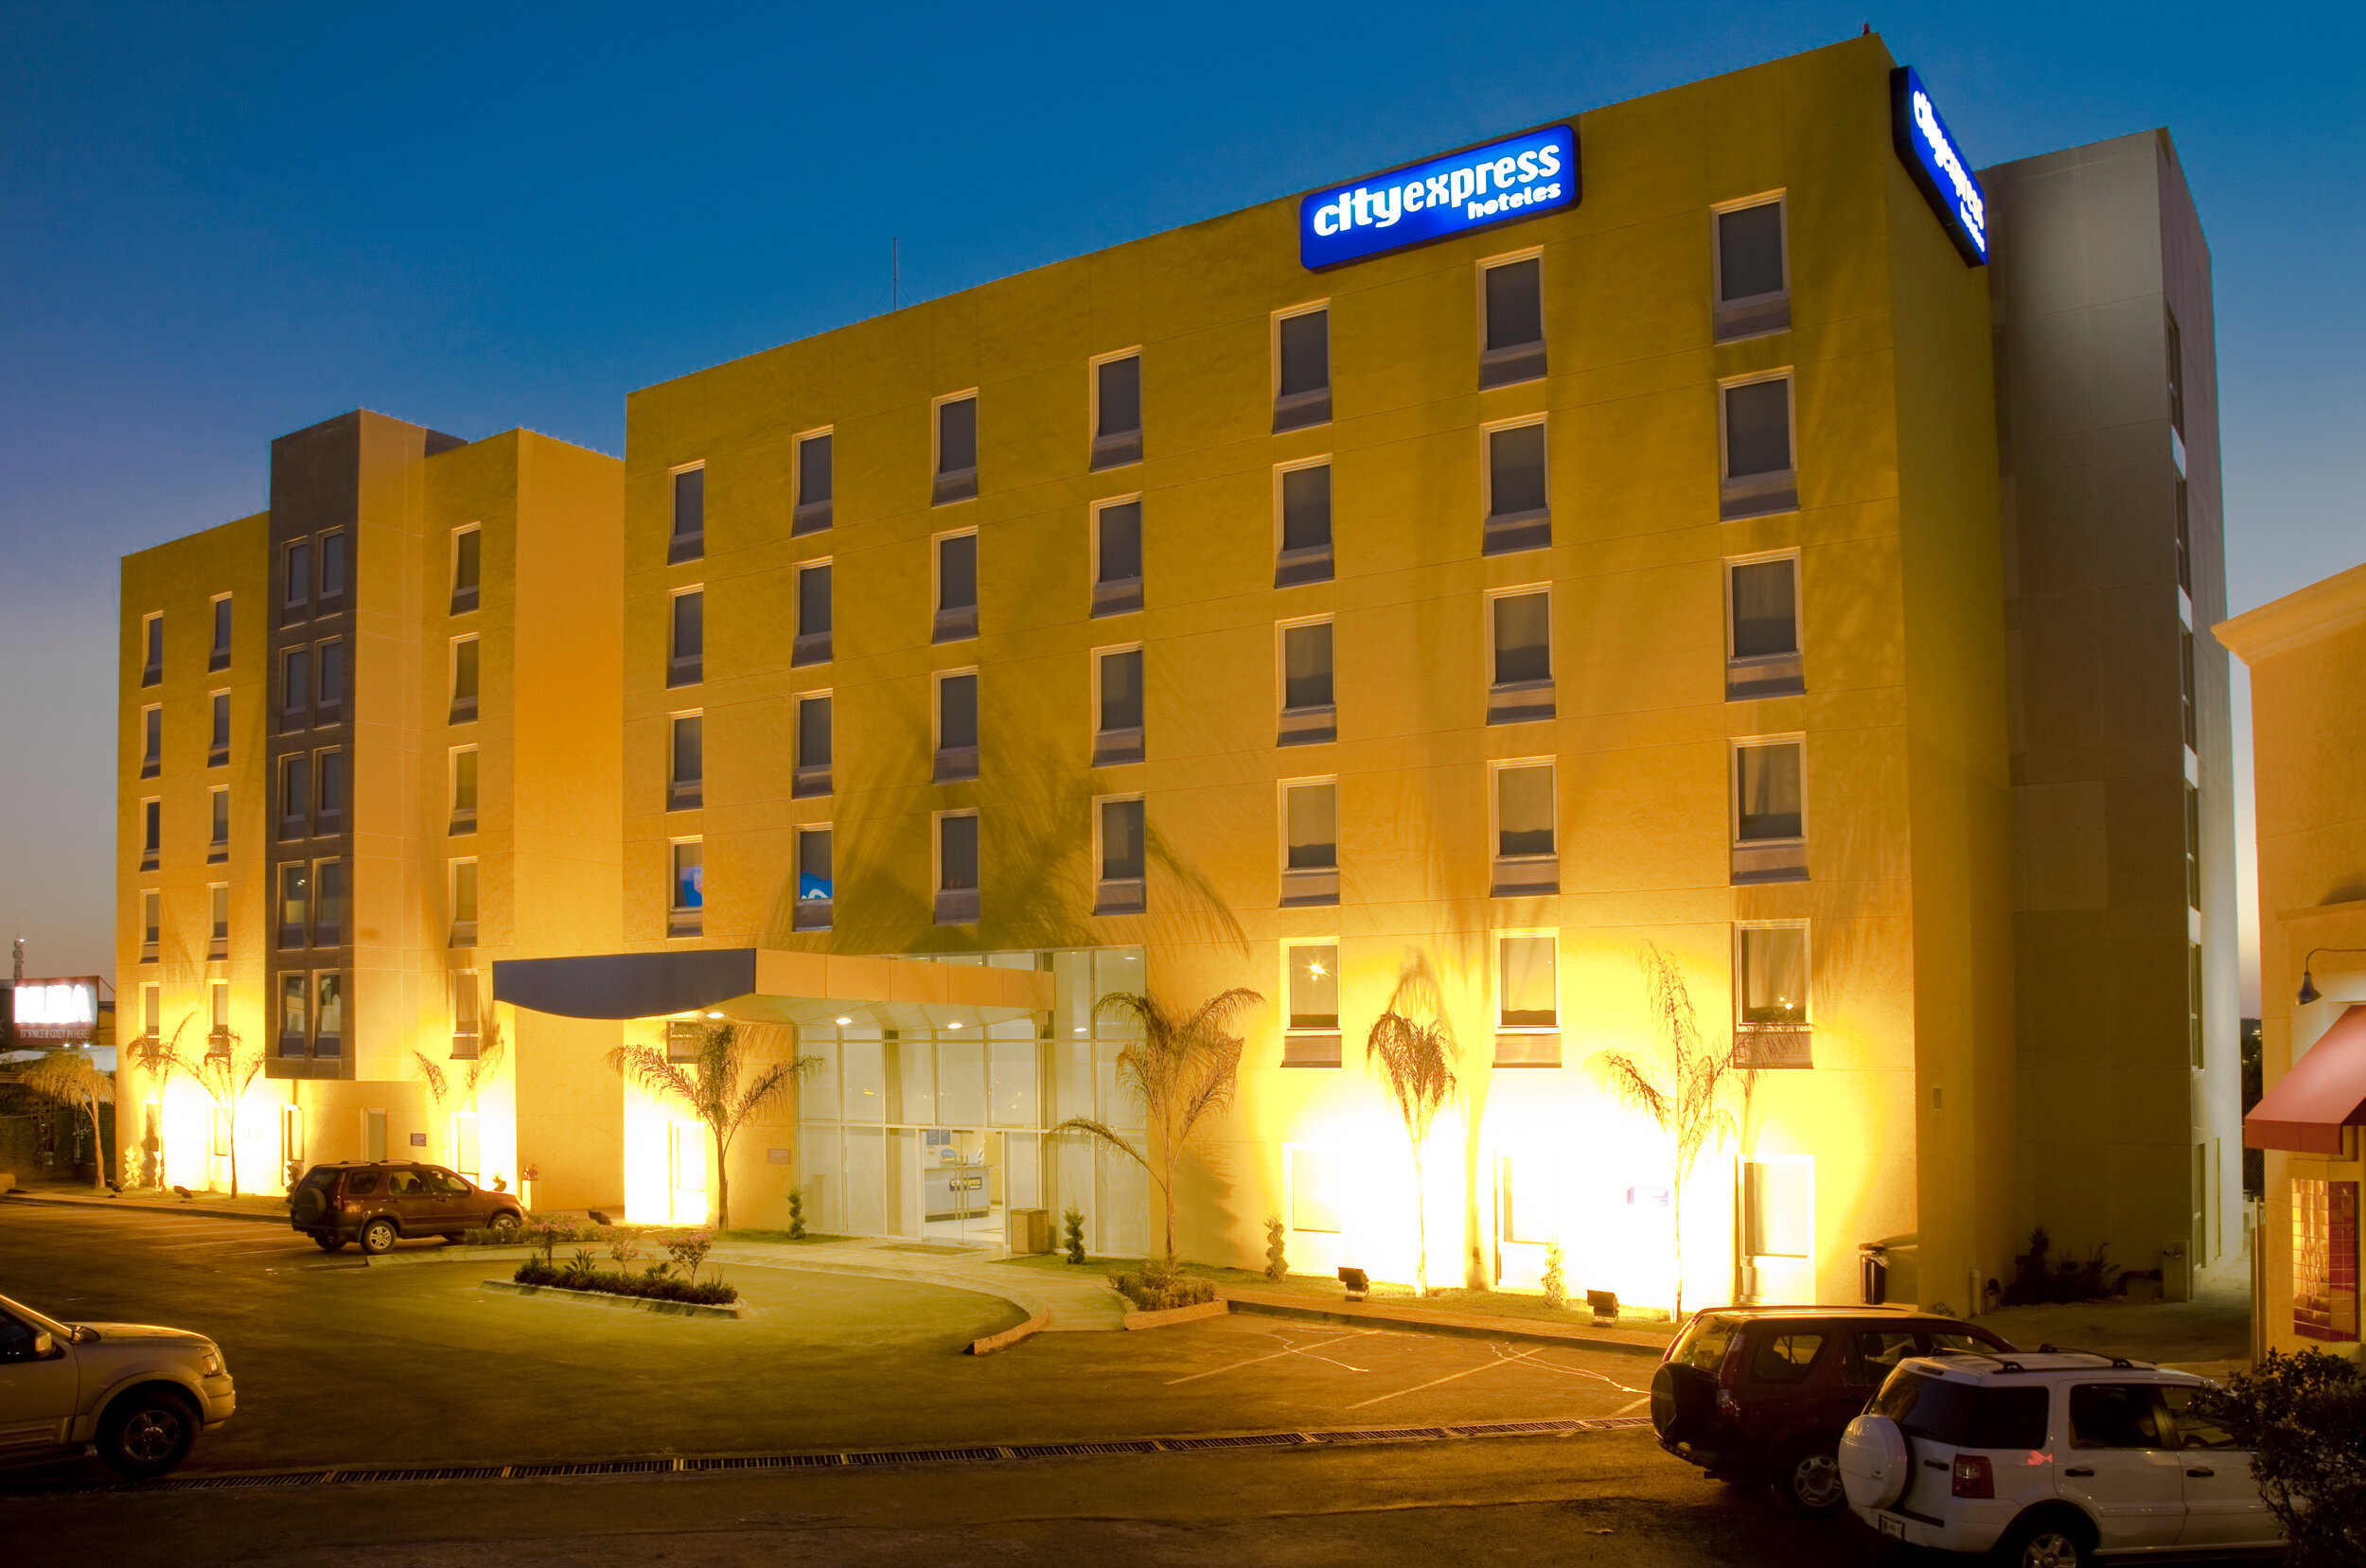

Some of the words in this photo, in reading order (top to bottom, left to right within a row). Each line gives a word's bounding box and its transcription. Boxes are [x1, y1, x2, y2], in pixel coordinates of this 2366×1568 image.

[1313, 144, 1562, 237] cityexpress
[1467, 182, 1562, 220] hoteles
[50, 1029, 65, 1038] COZY
